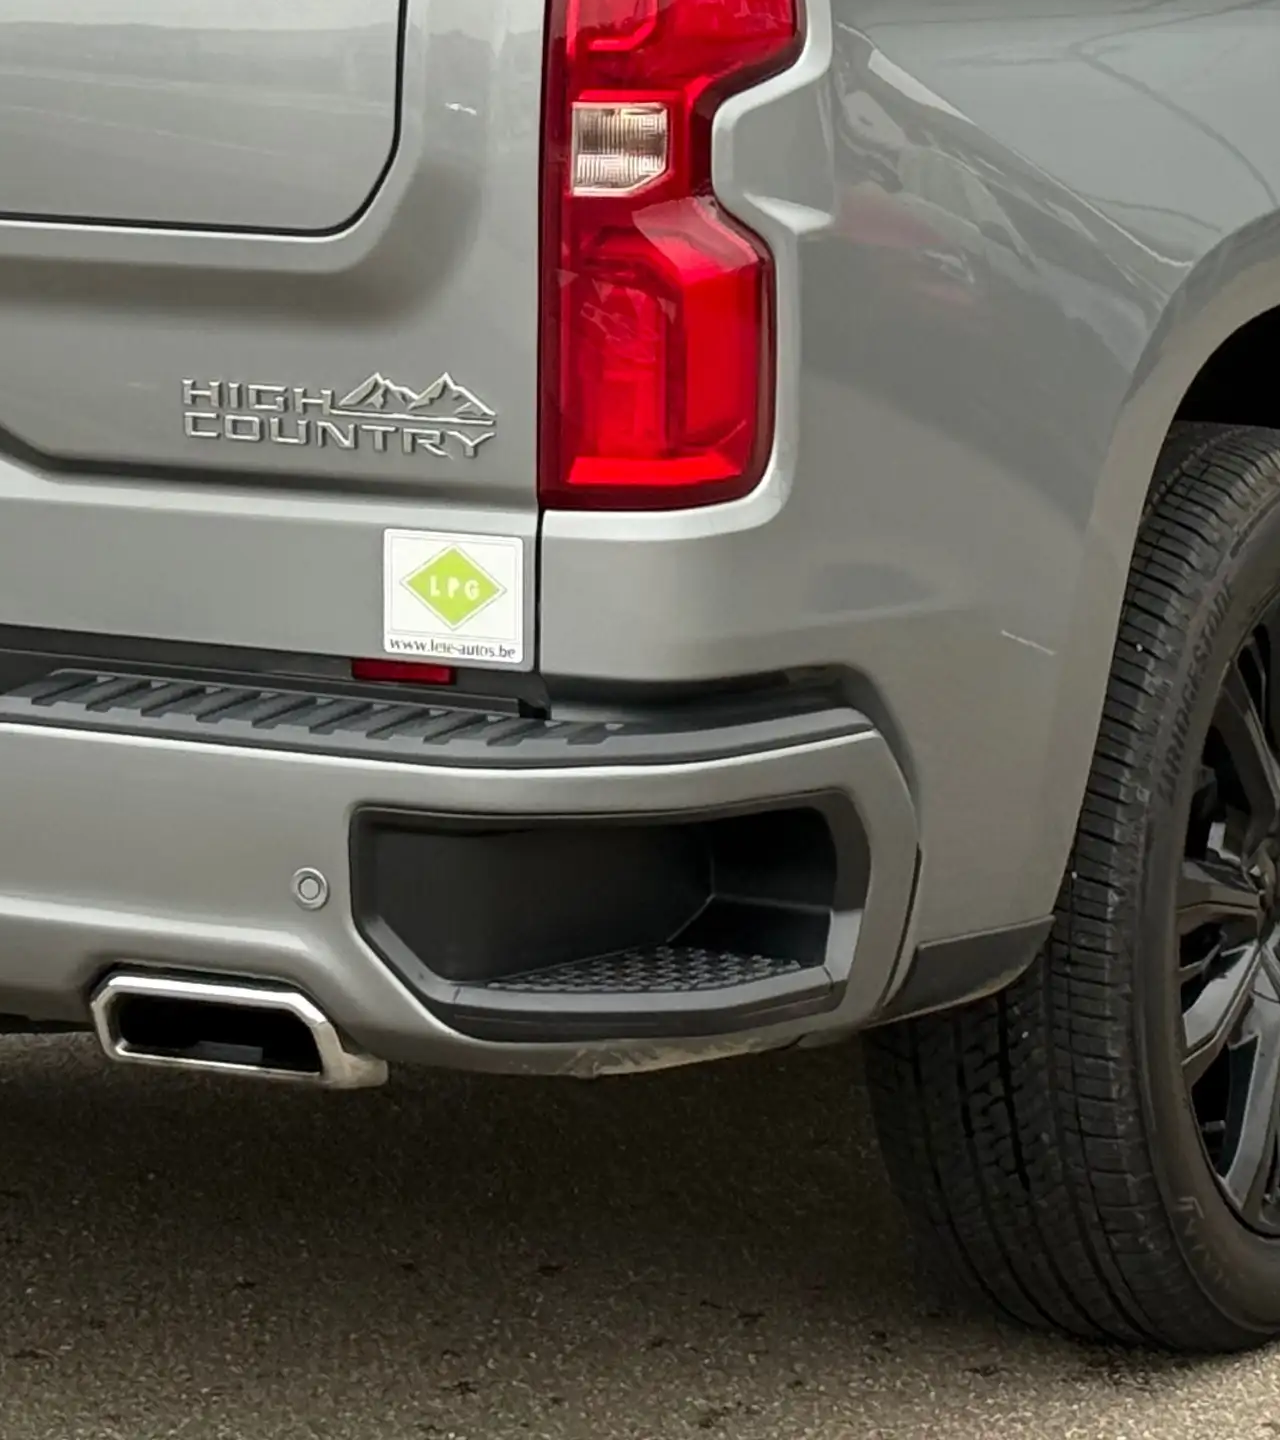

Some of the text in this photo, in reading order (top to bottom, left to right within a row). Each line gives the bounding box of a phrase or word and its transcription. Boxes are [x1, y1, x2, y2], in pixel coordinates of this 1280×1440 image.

[181, 377, 336, 416] HIGH
[183, 410, 497, 460] COUNTRY
[428, 572, 481, 601] LPG
